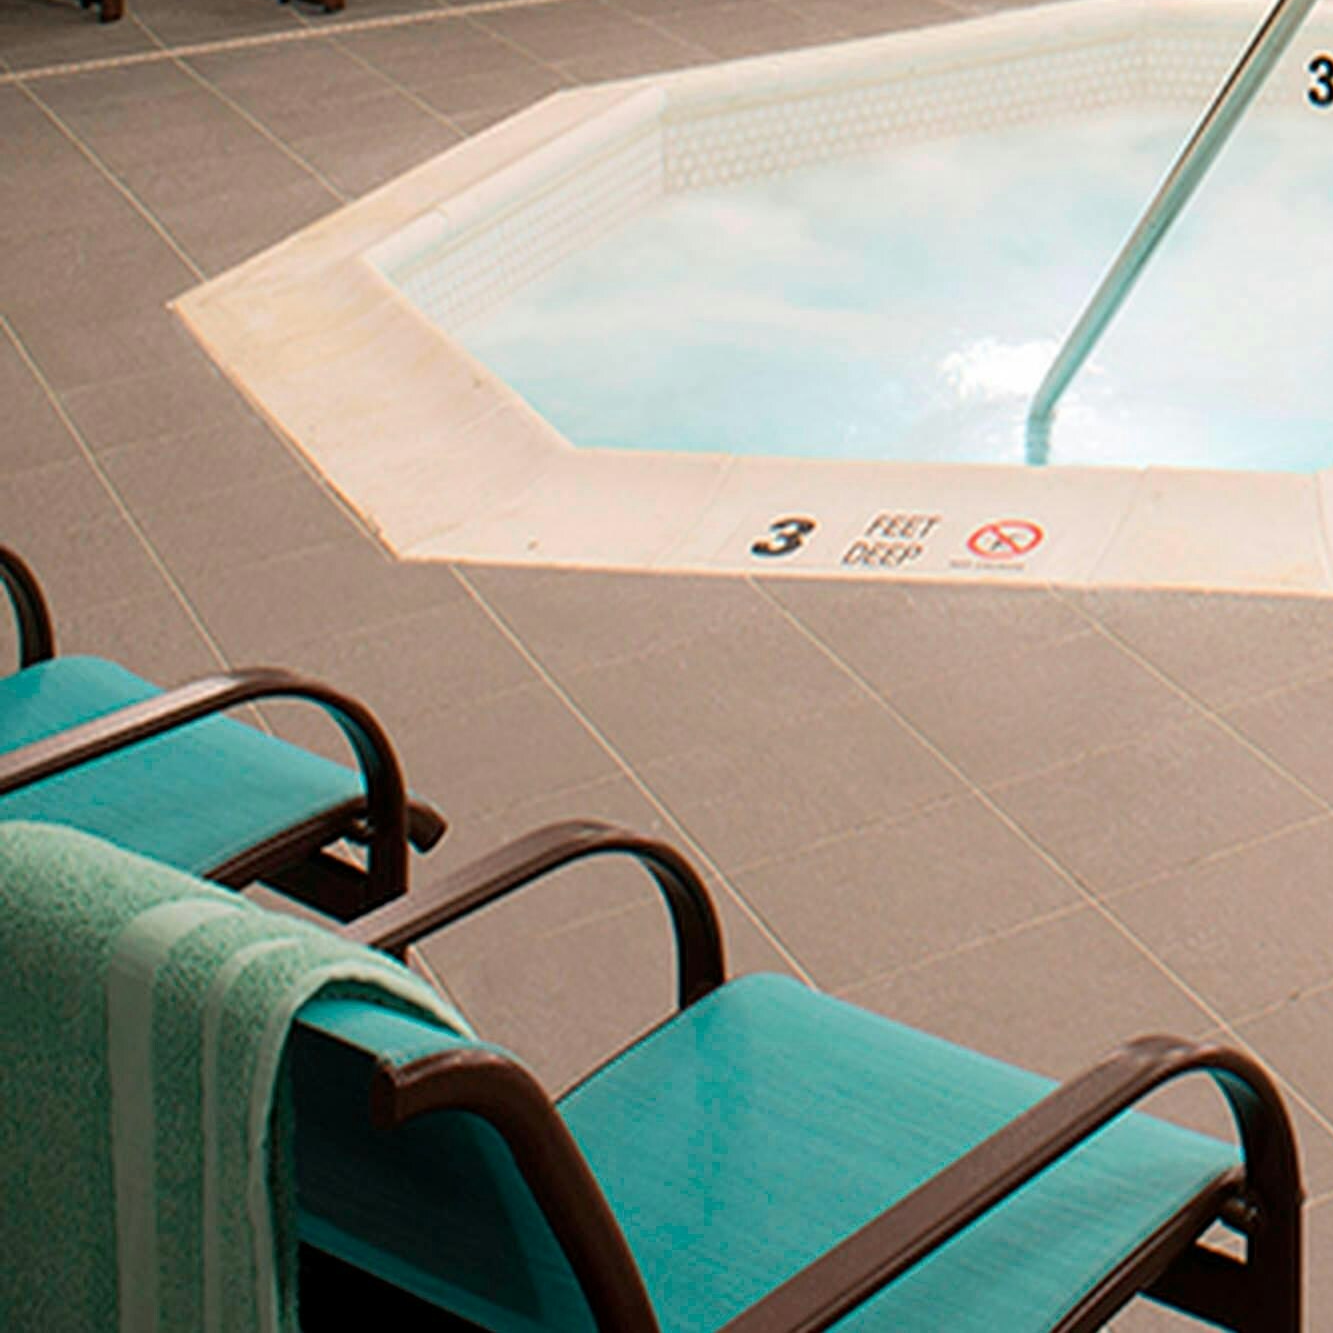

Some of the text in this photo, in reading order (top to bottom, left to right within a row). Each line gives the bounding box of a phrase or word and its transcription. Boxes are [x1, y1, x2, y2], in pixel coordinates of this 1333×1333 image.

[751, 514, 941, 558] 3 FEET
[842, 540, 924, 567] DEEP
